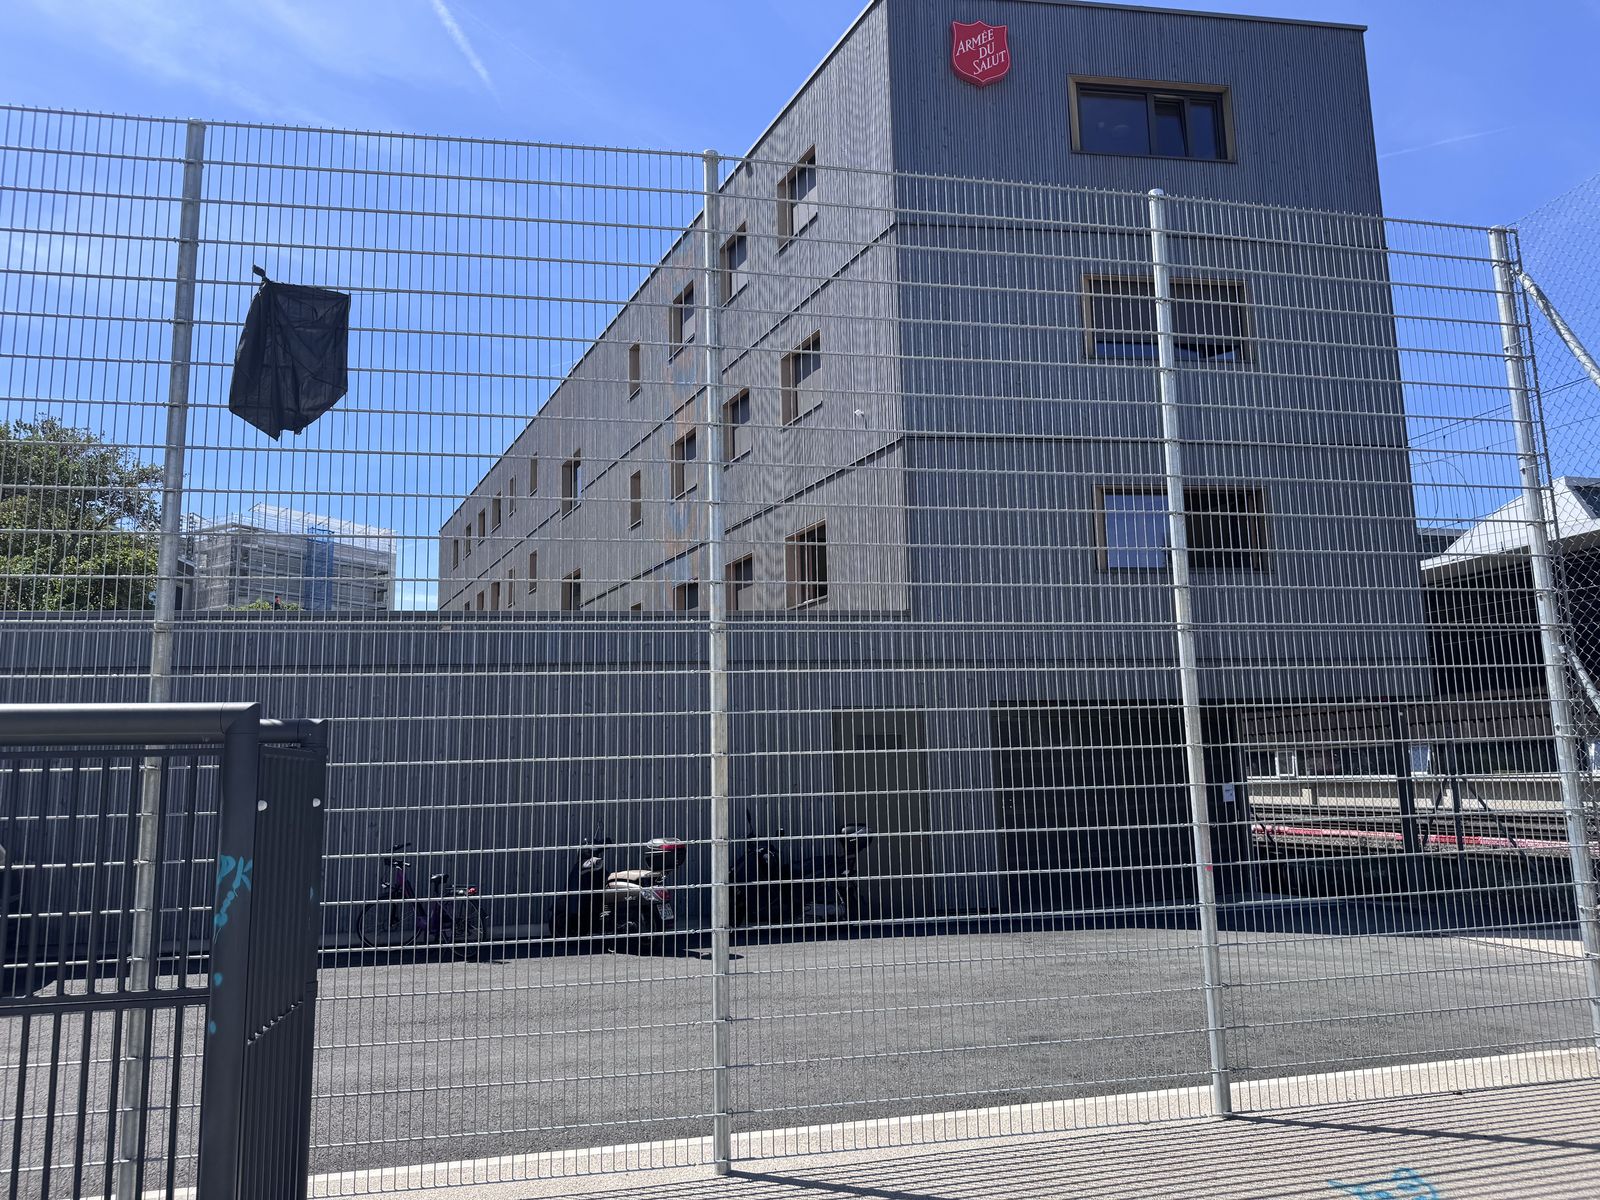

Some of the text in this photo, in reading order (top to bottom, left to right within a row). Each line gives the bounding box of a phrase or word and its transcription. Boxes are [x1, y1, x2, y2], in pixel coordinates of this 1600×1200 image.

[956, 28, 994, 57] ARMÉE
[979, 42, 995, 59] DU
[972, 50, 1006, 75] SALUT
